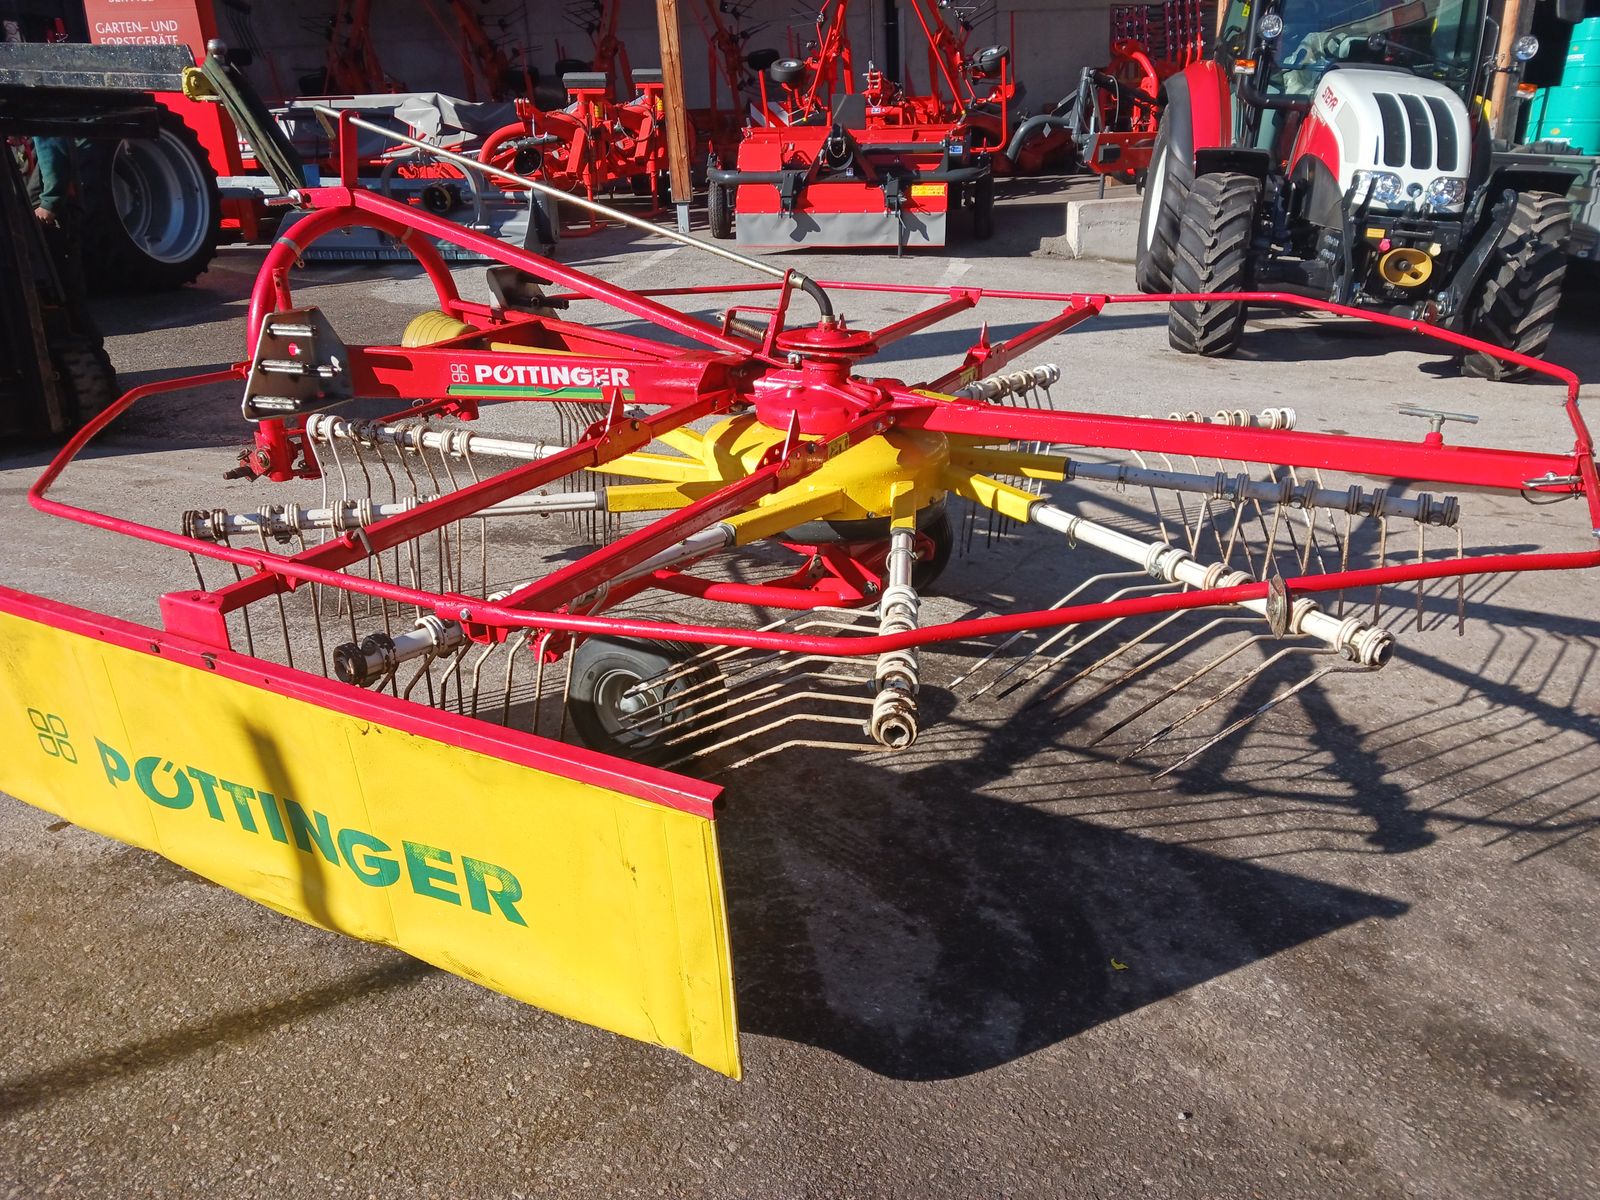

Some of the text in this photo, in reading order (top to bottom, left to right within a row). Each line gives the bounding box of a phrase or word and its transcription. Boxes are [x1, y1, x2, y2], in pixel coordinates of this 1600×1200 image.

[95, 20, 178, 34] GARTEN- UND
[1321, 85, 1339, 112] STEYR
[94, 735, 529, 929] PÖTTINGER
